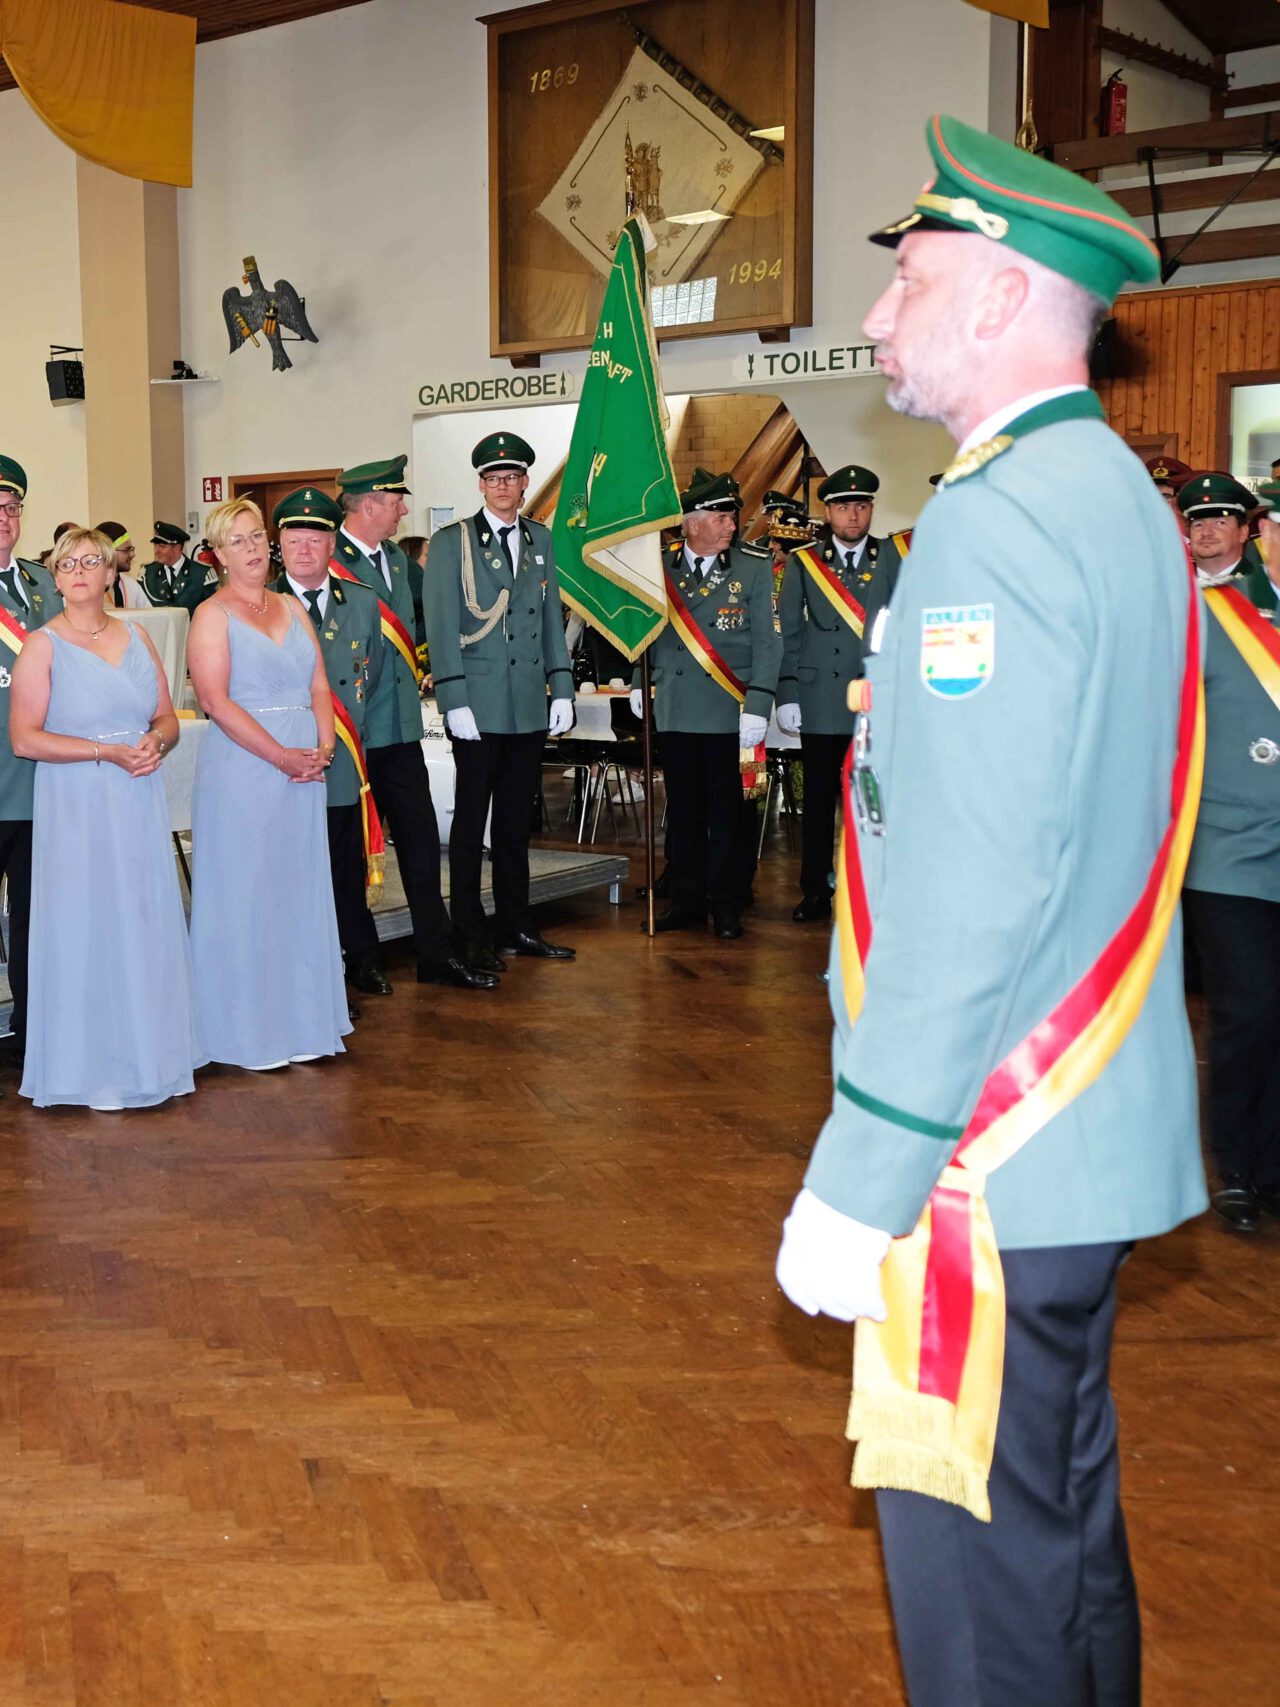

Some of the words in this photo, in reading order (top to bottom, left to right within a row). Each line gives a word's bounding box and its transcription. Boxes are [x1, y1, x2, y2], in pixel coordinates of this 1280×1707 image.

[529, 63, 580, 93] 1869
[728, 258, 783, 286] 1994
[418, 373, 557, 406] GARDEROBE
